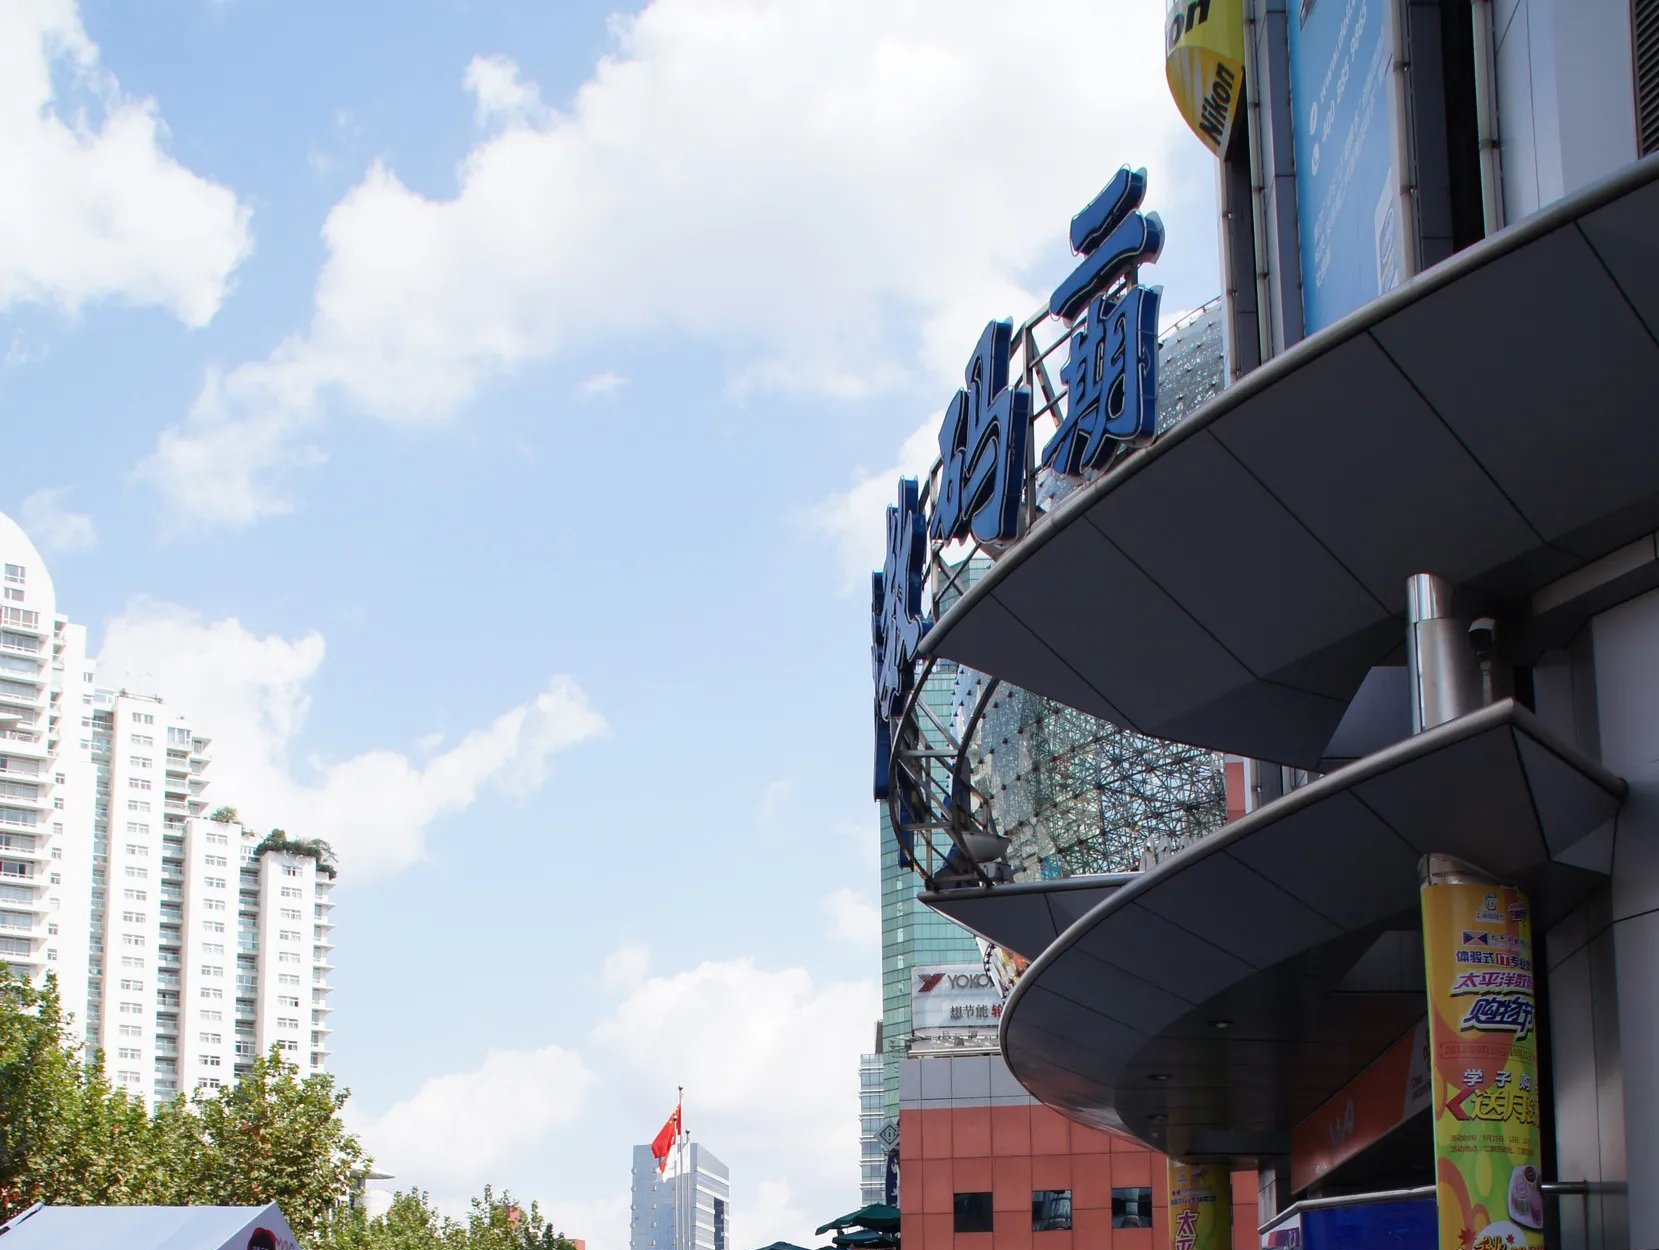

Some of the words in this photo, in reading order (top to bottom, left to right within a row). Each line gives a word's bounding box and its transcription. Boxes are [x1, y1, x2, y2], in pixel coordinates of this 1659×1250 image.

[1199, 61, 1235, 148] Nikon
[950, 1004, 989, 1020] 想节能
